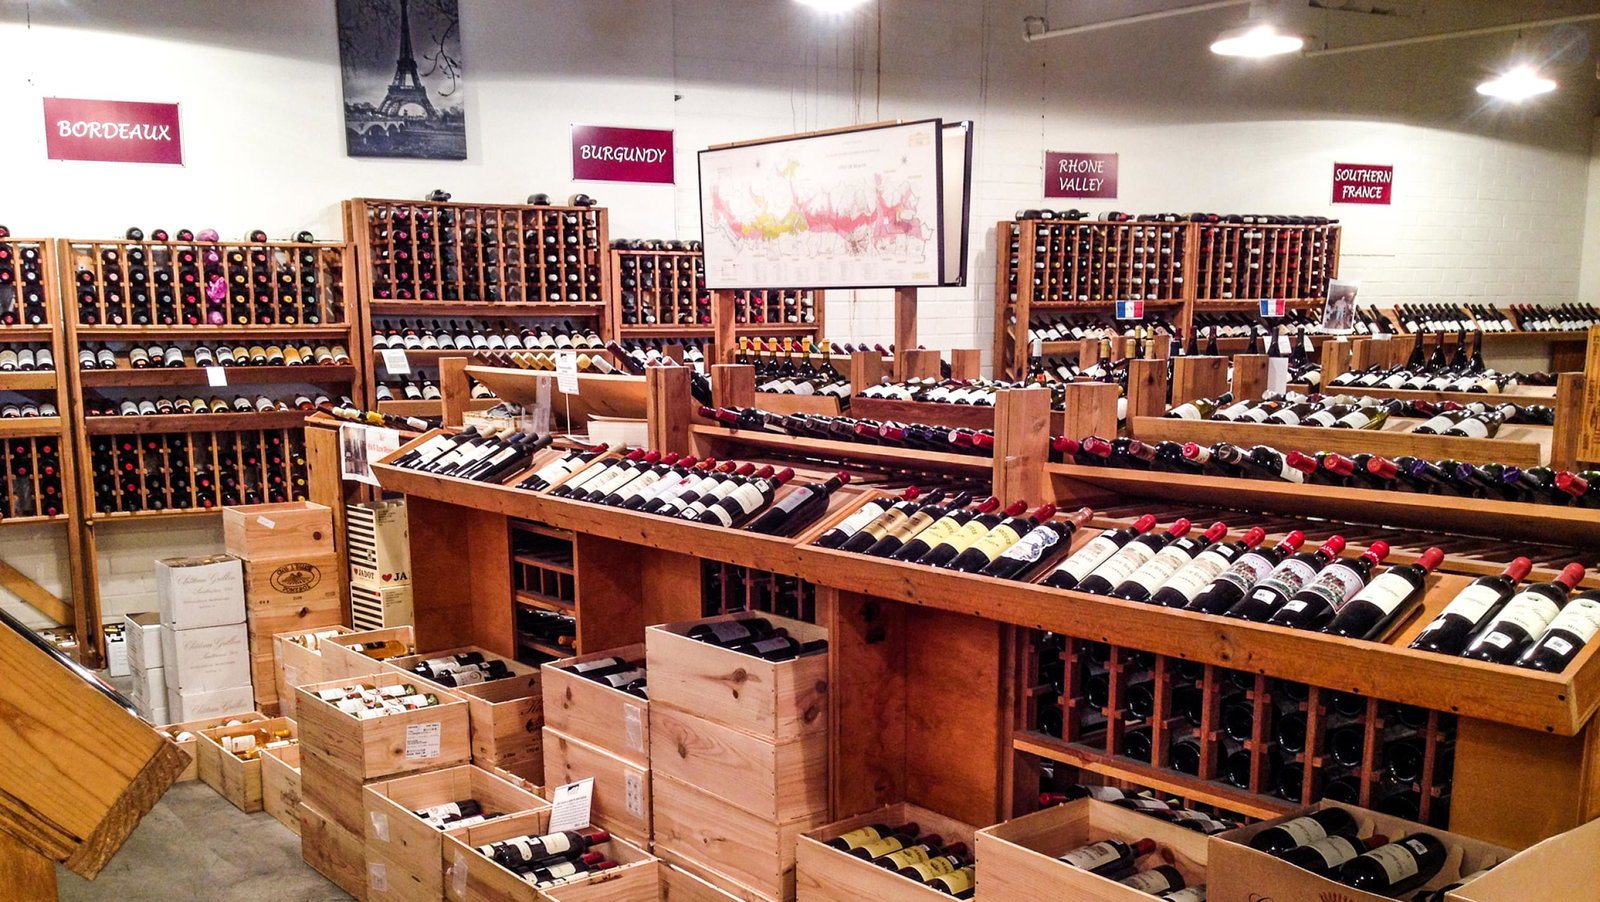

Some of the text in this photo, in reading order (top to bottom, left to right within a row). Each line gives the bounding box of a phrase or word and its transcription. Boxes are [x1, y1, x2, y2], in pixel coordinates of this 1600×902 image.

[57, 119, 171, 141] BORDEAUX
[580, 144, 667, 163] BURGUNDY
[1058, 158, 1105, 173] RHONE
[1335, 168, 1392, 183] SOUTHERN
[1059, 176, 1104, 192] VALLEY
[1342, 185, 1383, 199] FRANCE
